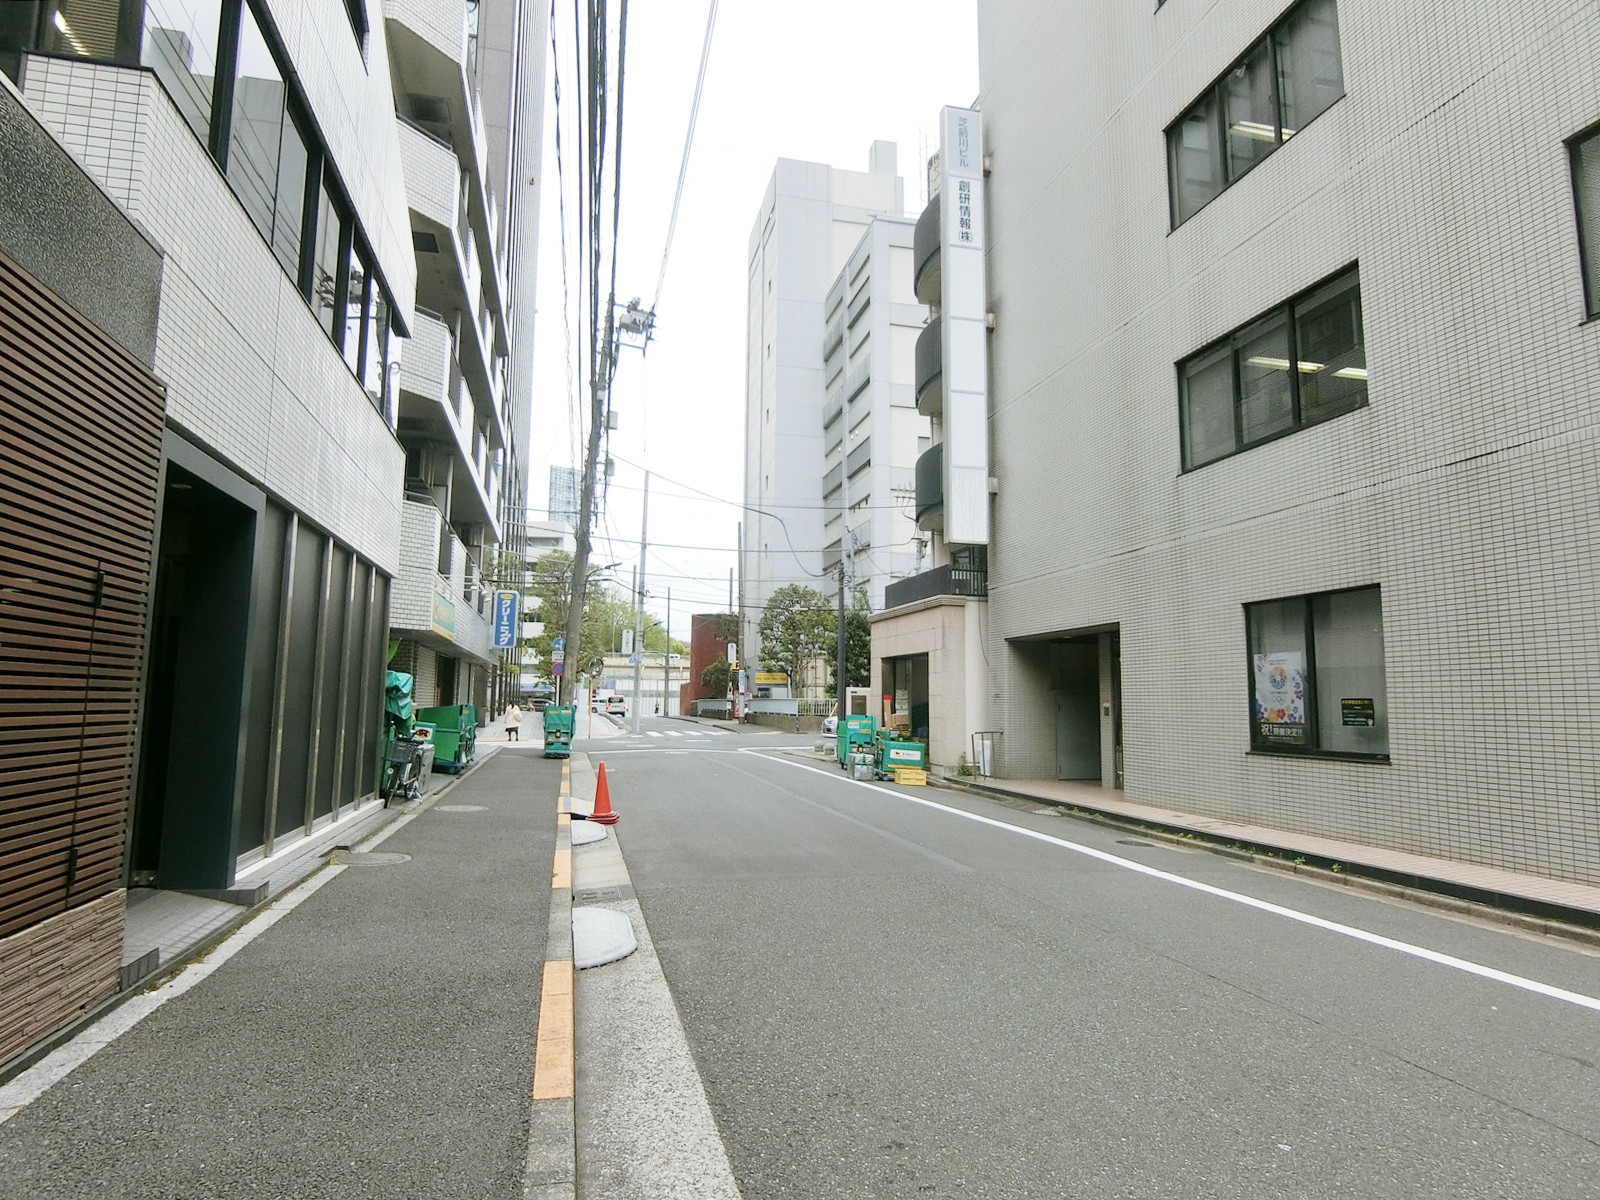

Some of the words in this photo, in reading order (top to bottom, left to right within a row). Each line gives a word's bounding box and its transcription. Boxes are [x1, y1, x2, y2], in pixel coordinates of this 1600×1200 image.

[500, 600, 511, 645] クリーニング
